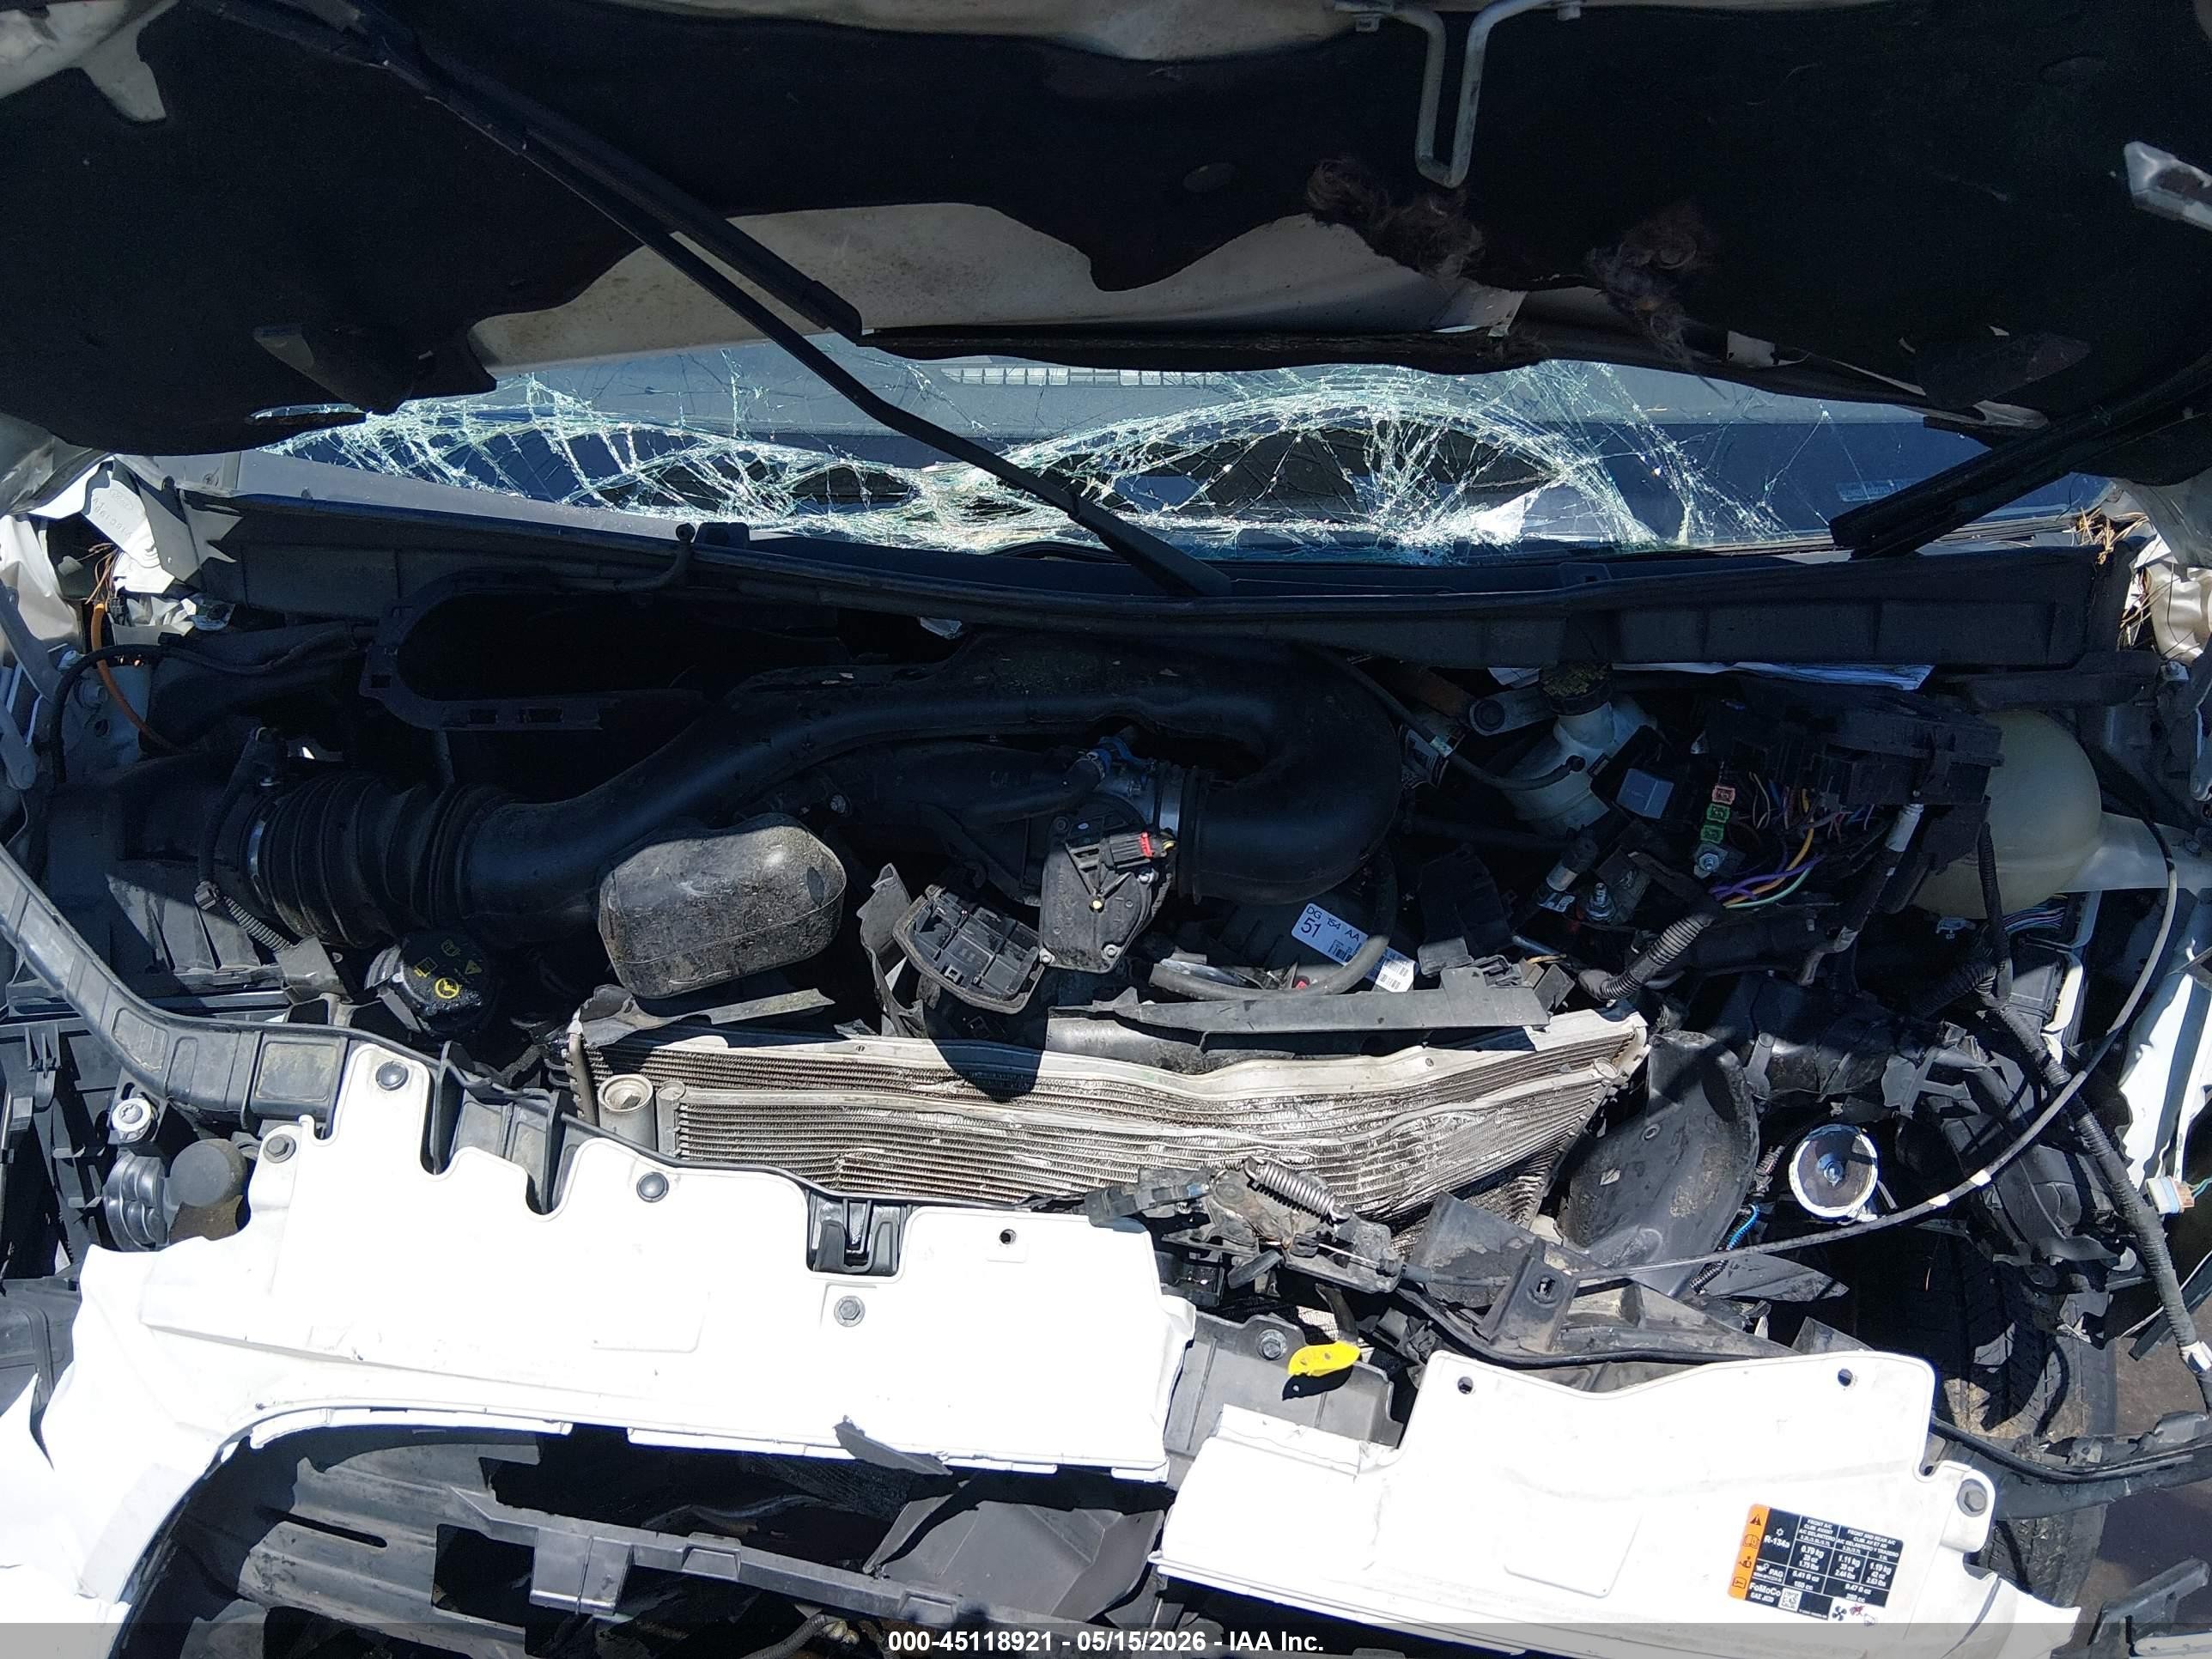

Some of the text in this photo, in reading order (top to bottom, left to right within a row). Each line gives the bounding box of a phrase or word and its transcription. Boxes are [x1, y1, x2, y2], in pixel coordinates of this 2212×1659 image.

[1300, 917, 1322, 939] 51
[1306, 906, 1360, 942] DG 154 AA
[1763, 1534, 1790, 1548] R-134a
[1814, 1548, 1825, 1559] kg
[1837, 1554, 1861, 1568] 1.11 kg
[1768, 1568, 1784, 1577] PAG
[1869, 1562, 1892, 1576] 1.19 kg
[1748, 1581, 1782, 1596] FoMoCo
